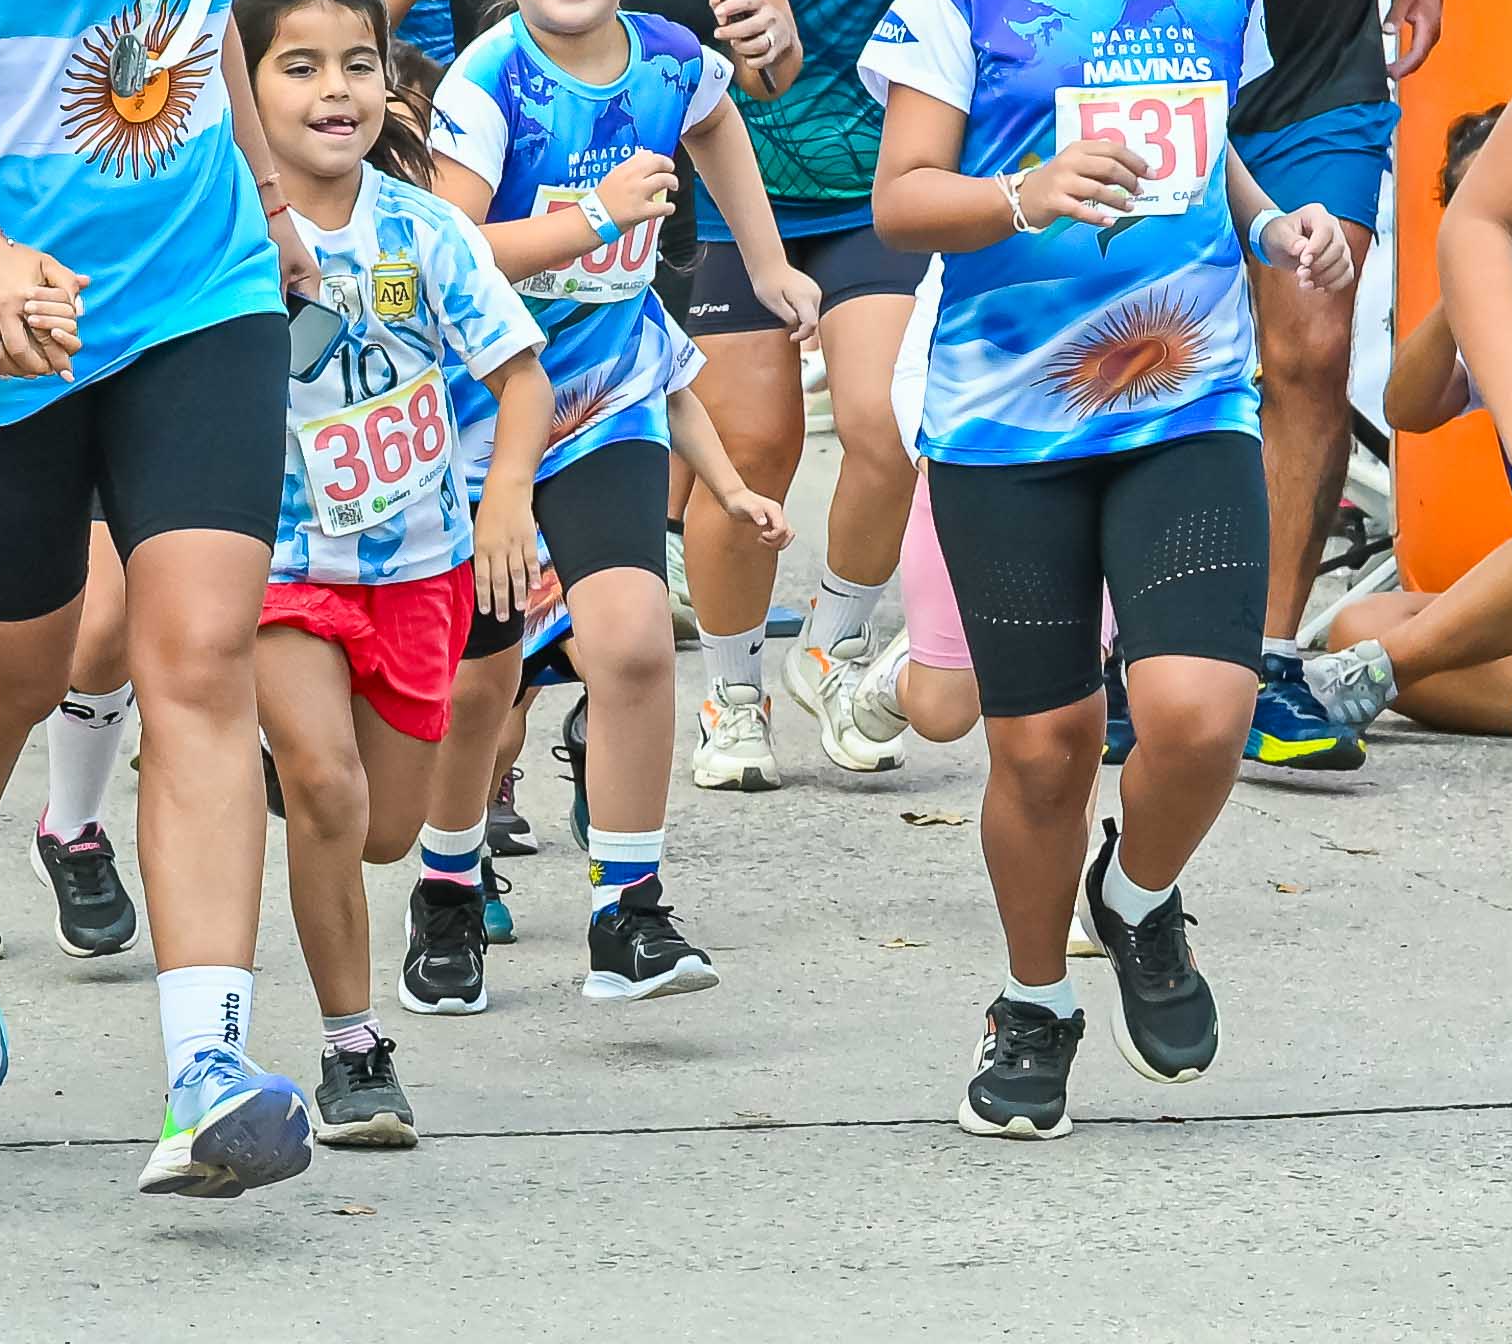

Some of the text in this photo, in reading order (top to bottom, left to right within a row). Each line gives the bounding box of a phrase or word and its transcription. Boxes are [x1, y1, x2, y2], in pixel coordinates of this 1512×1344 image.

[1092, 24, 1195, 44] MARATÓN
[1175, 42, 1197, 55] DE
[1083, 57, 1213, 85] MALVINAS
[1079, 97, 1208, 181] 531
[313, 383, 446, 502] 368
